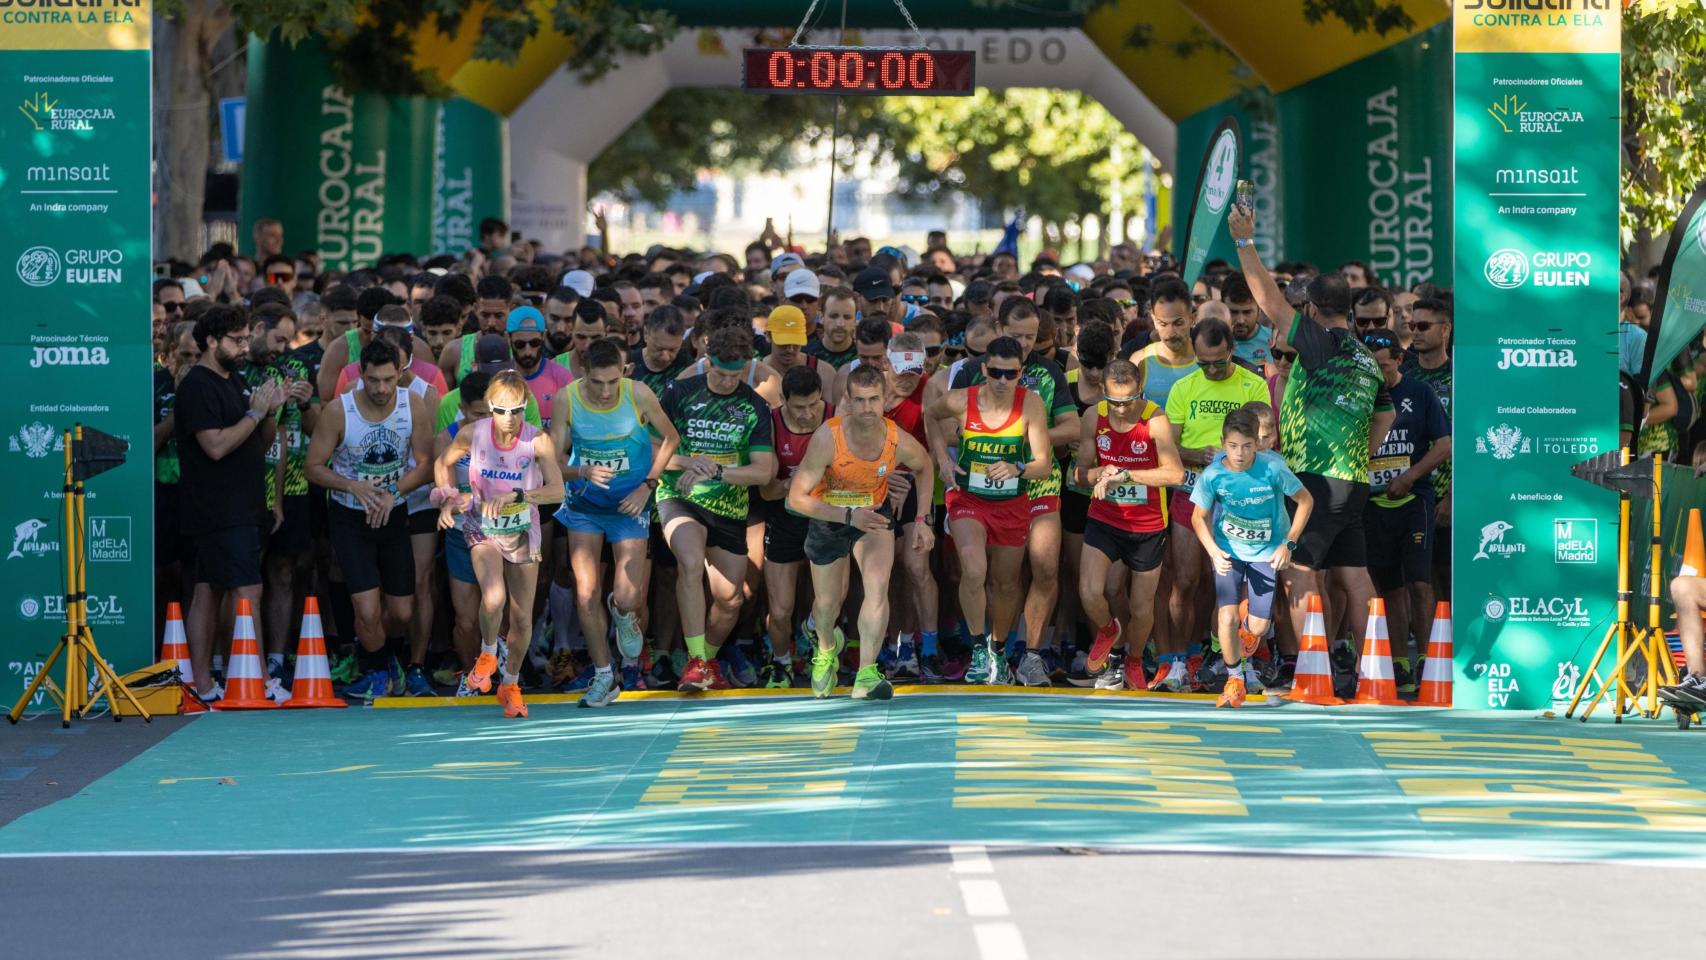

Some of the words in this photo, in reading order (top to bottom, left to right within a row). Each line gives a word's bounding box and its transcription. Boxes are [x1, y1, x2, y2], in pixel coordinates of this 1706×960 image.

[4, 11, 73, 24] CONTRA
[78, 11, 97, 24] LA
[103, 11, 134, 24] ELA
[1473, 14, 1542, 26] CONTRA
[1548, 14, 1567, 26] LA
[1574, 14, 1603, 26] ELA
[768, 51, 934, 88] 0:00:00
[24, 75, 79, 83] Patrocinadores
[81, 75, 114, 83] Oficiales
[1493, 77, 1549, 86] Patrocinadores
[1551, 77, 1583, 86] Oficiales
[51, 109, 115, 120] EUROCAJA
[1520, 112, 1584, 122] EUROCAJA
[51, 120, 94, 130] RURAL
[1520, 123, 1562, 133] RURAL
[27, 163, 110, 181] minsait
[1496, 166, 1579, 184] minsait
[30, 203, 42, 212] An
[44, 203, 66, 212] Indra
[68, 204, 109, 214] company
[1498, 206, 1511, 214] An
[1512, 206, 1535, 214] Indra
[1537, 206, 1577, 216] company
[65, 249, 123, 265] GRUPO
[1533, 252, 1591, 268] GRUPO
[66, 268, 122, 284] EULEN
[1533, 271, 1590, 287] EULEN
[30, 334, 78, 343] Patrocinador
[80, 333, 109, 343] Técnico
[1498, 337, 1545, 346] Patrocinador
[1547, 336, 1577, 346] Técnico
[30, 404, 58, 413] Entidad
[59, 404, 109, 413] Colaboradora
[1498, 406, 1525, 414] Entidad
[1527, 406, 1577, 414] Colaboradora
[1543, 443, 1599, 454] TOLEDO
[481, 468, 523, 480] PALOMA
[984, 478, 1005, 489] 90
[43, 491, 49, 499] A
[87, 491, 96, 499] de
[1510, 493, 1516, 501] A
[1517, 493, 1552, 501] beneficio
[1553, 493, 1563, 501] de
[492, 514, 522, 529] 174
[1227, 523, 1266, 540] 2284
[92, 538, 128, 548] adELA
[1557, 540, 1594, 550] adELA
[92, 549, 128, 559] Madrid
[1557, 551, 1594, 561] Madrid
[43, 595, 123, 618] ELCyL
[1508, 598, 1588, 619] ELACyL
[1487, 663, 1511, 677] AD
[1487, 678, 1519, 692] ELA
[1487, 693, 1509, 707] CV
